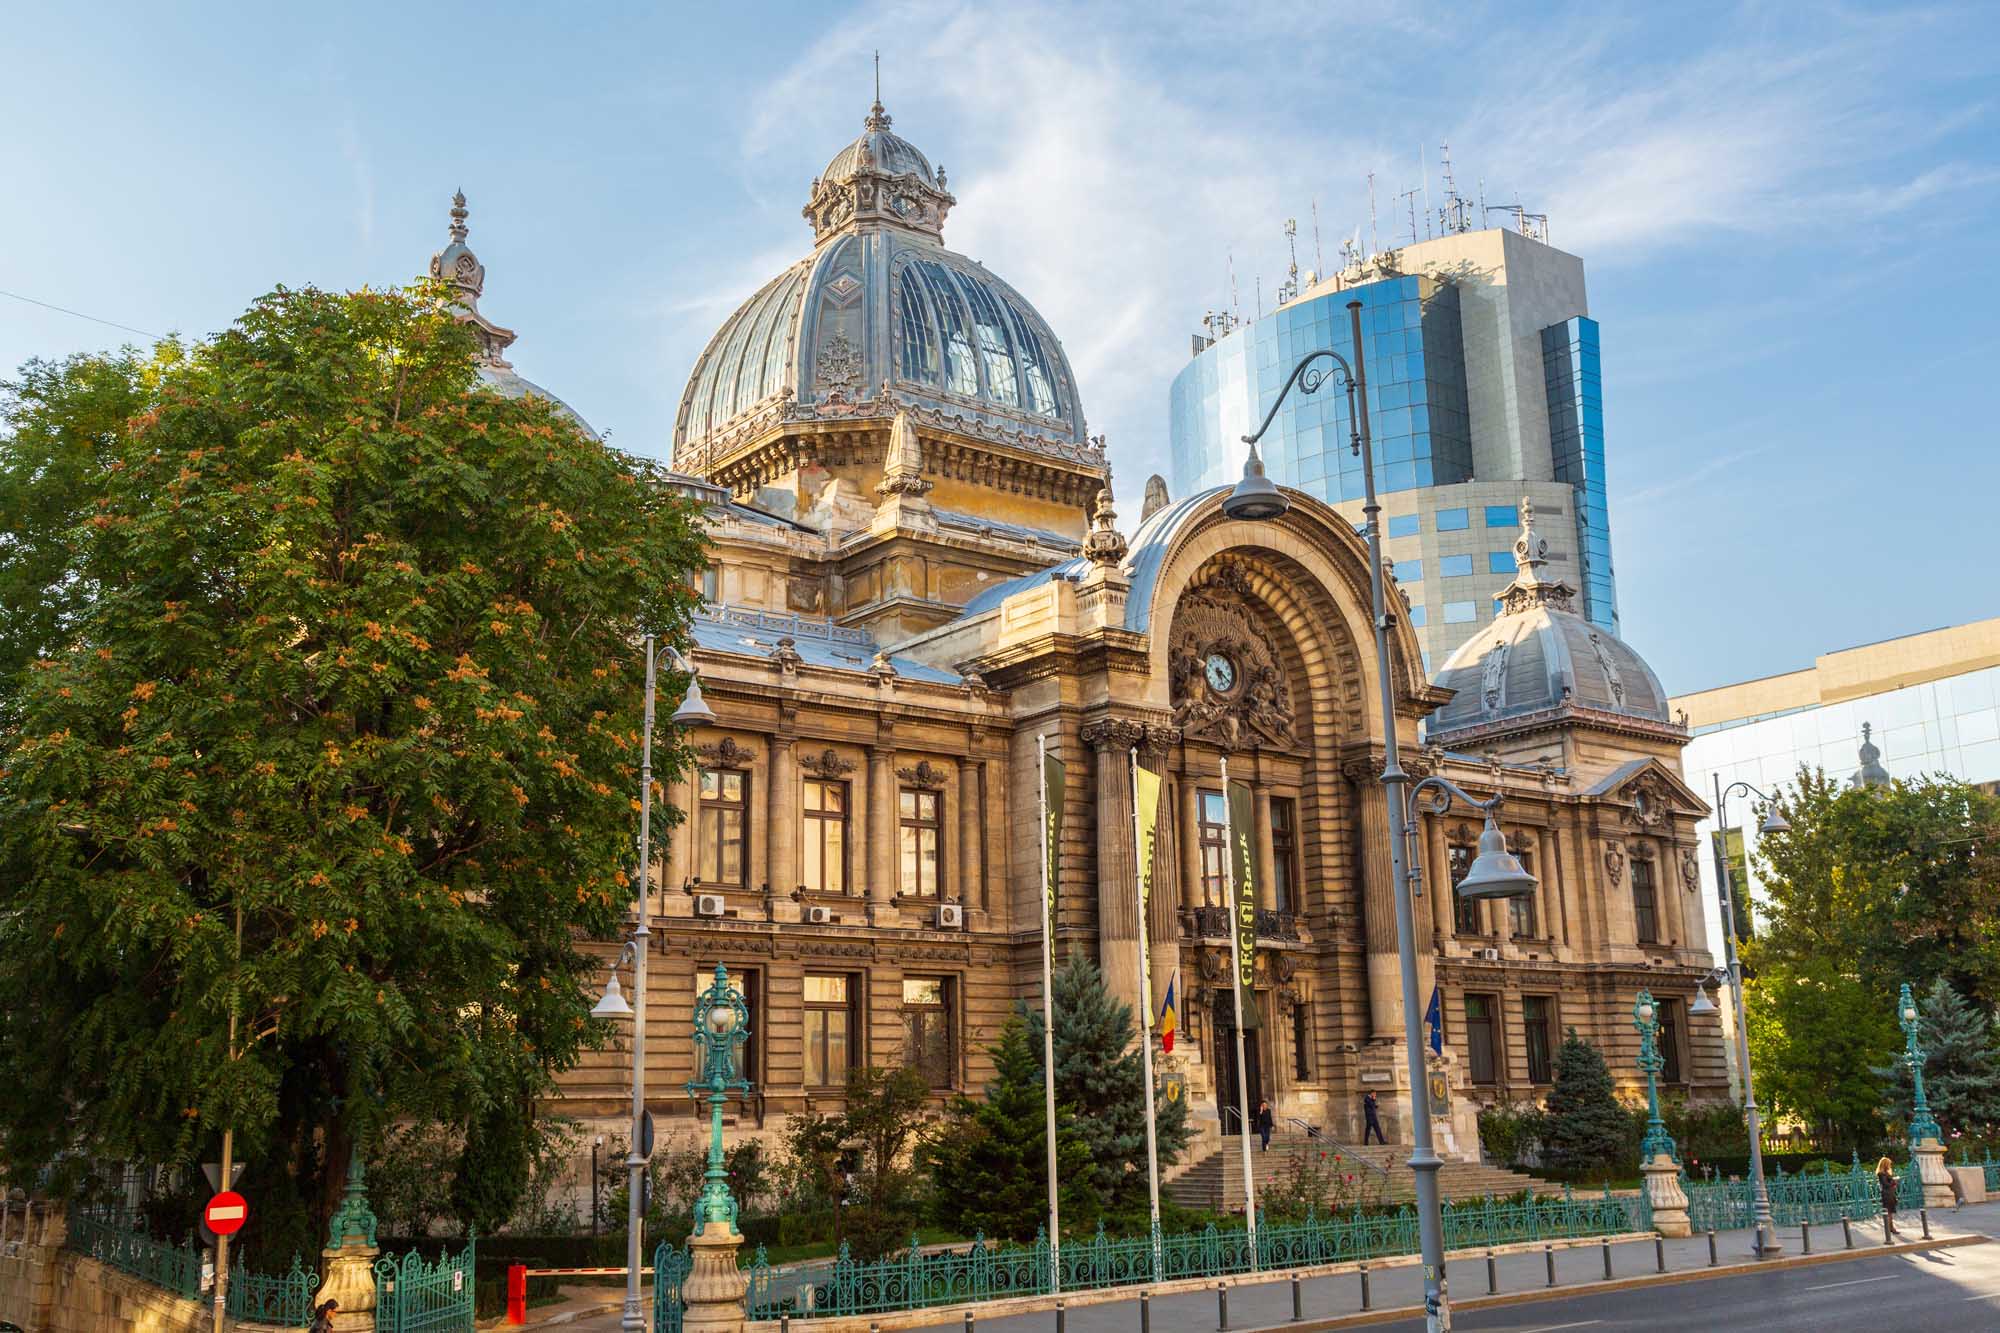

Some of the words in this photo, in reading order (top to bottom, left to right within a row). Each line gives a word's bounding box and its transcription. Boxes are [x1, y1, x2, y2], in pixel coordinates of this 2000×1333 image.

[1143, 824, 1156, 889] Bank
[1239, 831, 1254, 897] Bank
[1240, 932, 1254, 987] CEC
